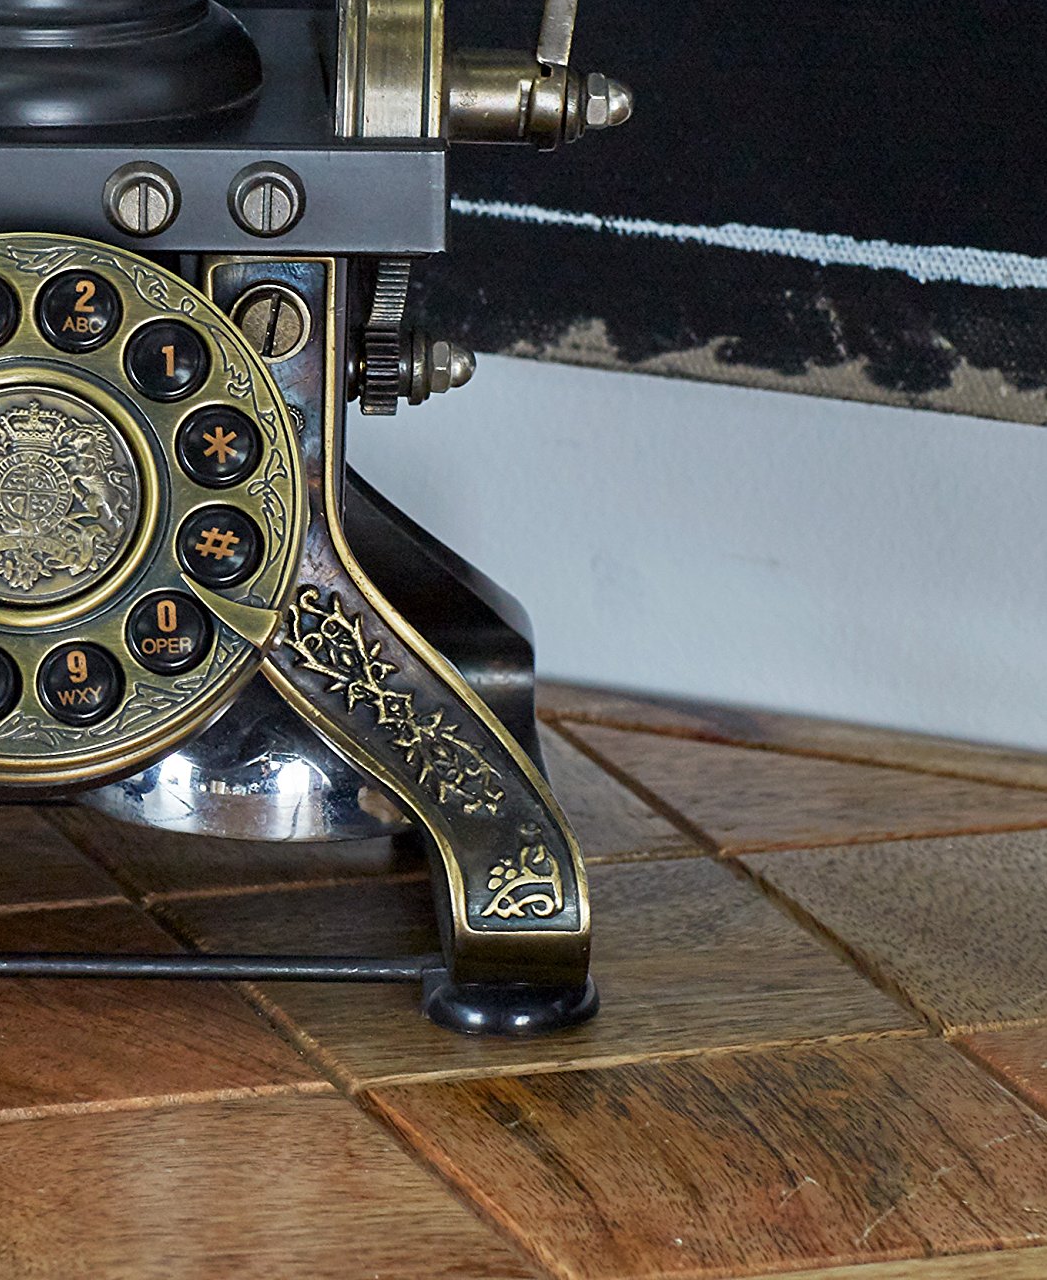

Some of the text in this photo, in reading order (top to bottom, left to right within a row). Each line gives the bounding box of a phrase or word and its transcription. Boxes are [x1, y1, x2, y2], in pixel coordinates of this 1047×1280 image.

[75, 280, 96, 312] 2
[63, 316, 103, 334] ABC
[161, 345, 175, 377] 1
[156, 600, 177, 632] 0
[141, 637, 192, 654] OPER
[67, 651, 88, 683] 9
[57, 687, 103, 706] WXY
